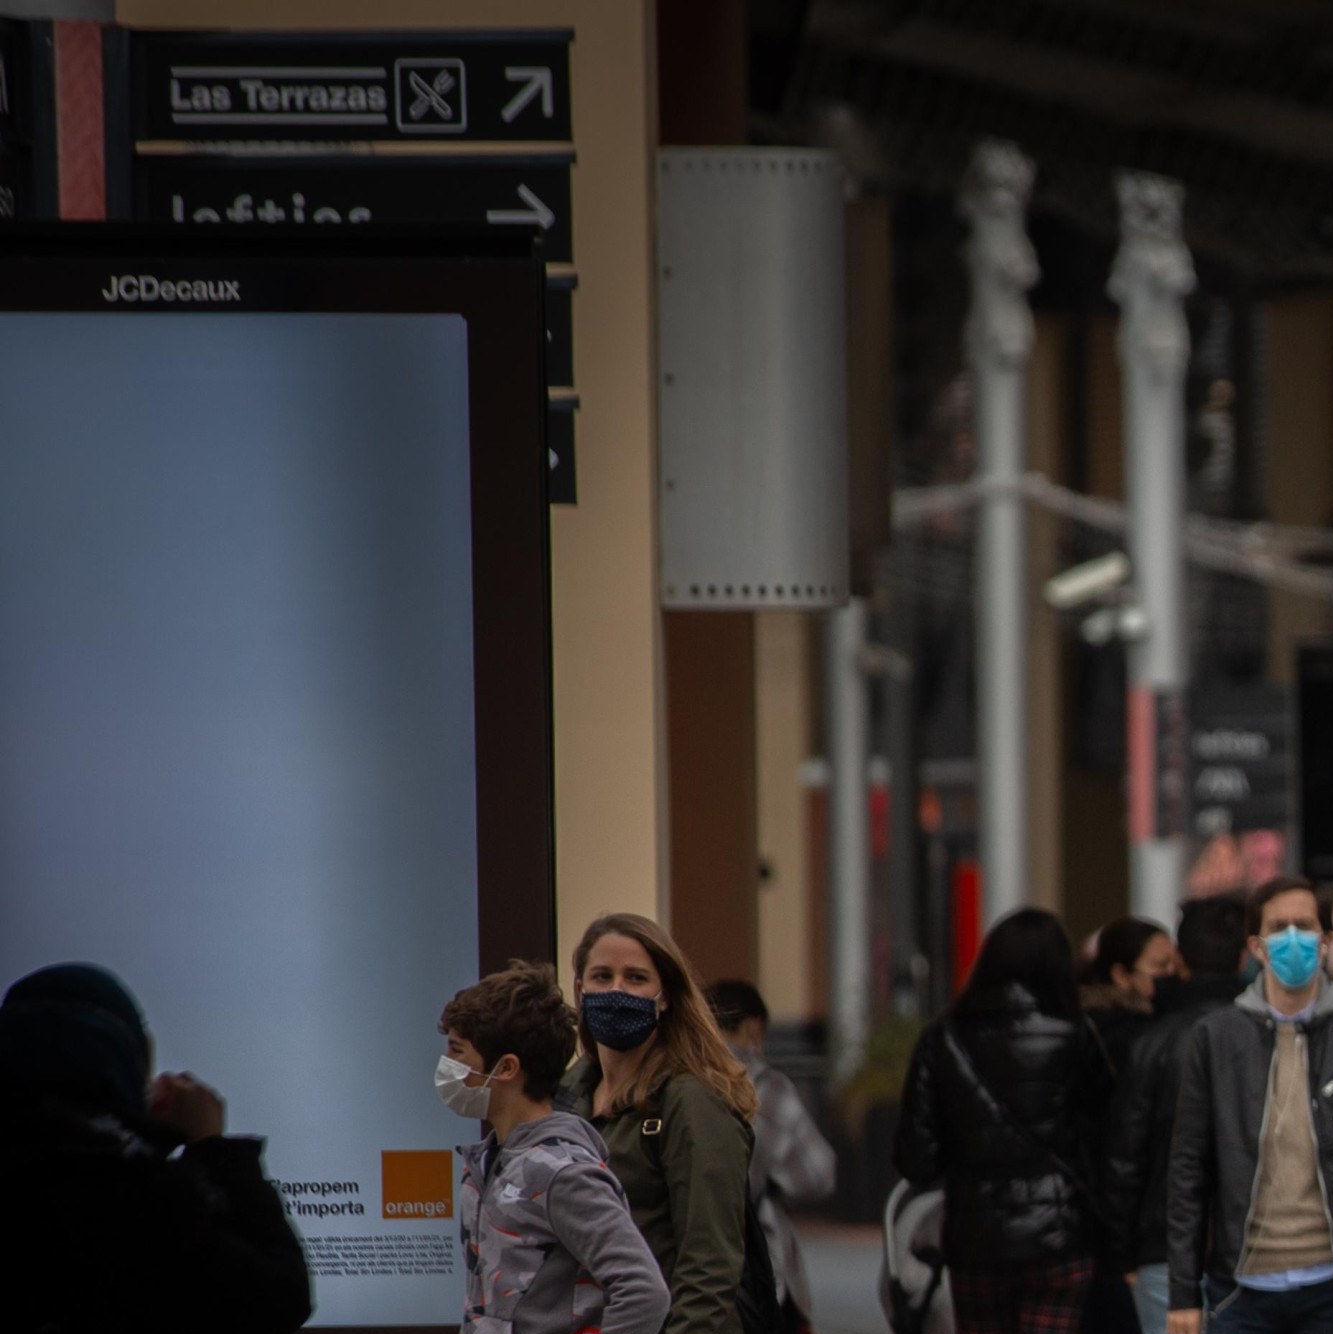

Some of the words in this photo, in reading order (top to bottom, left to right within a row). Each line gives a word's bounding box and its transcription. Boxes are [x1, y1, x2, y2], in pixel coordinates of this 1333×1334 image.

[170, 79, 232, 112] Las
[239, 78, 387, 112] Terrazas
[101, 274, 242, 302] JCDecaux
[385, 1200, 446, 1217] orange
